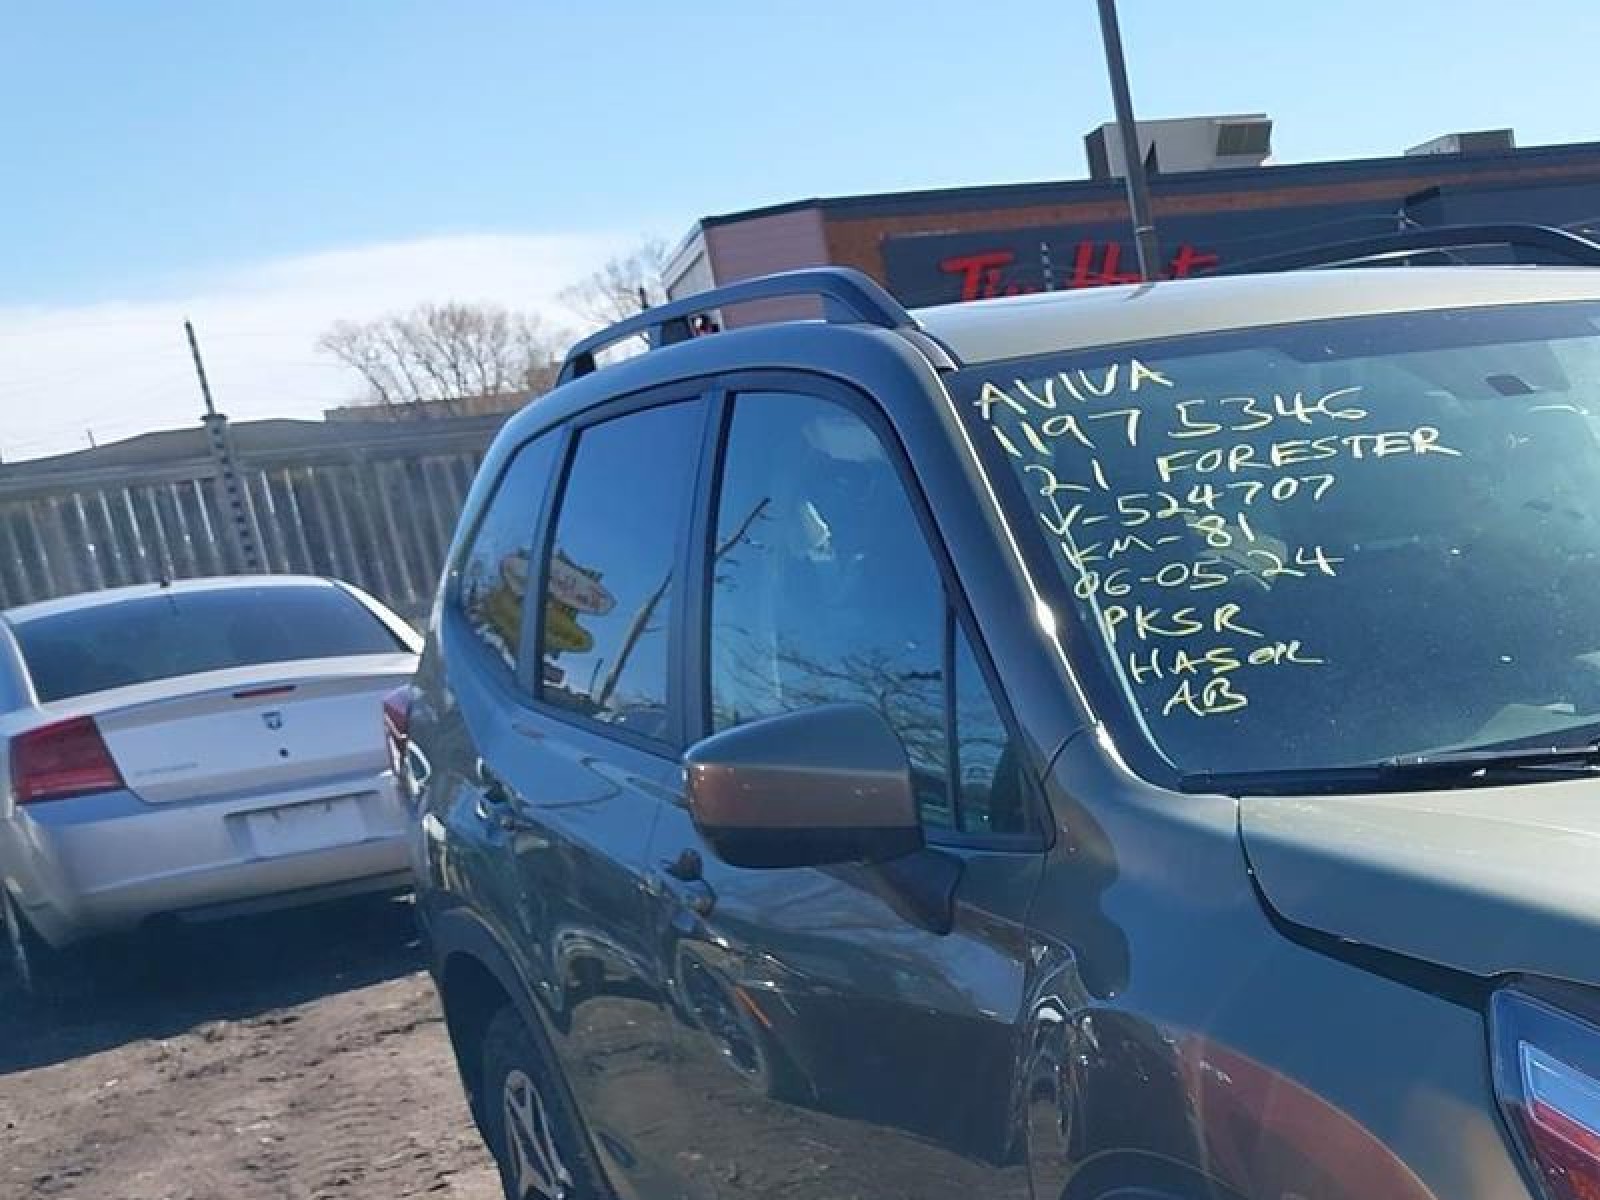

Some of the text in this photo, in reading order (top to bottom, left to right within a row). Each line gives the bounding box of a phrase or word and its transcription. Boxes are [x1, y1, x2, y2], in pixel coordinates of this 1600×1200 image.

[973, 358, 1175, 421] AVIVA
[1023, 426, 1463, 497] 21 FORESTER
[1073, 542, 1345, 600] 06-05-24
[1161, 677, 1249, 717] AB
